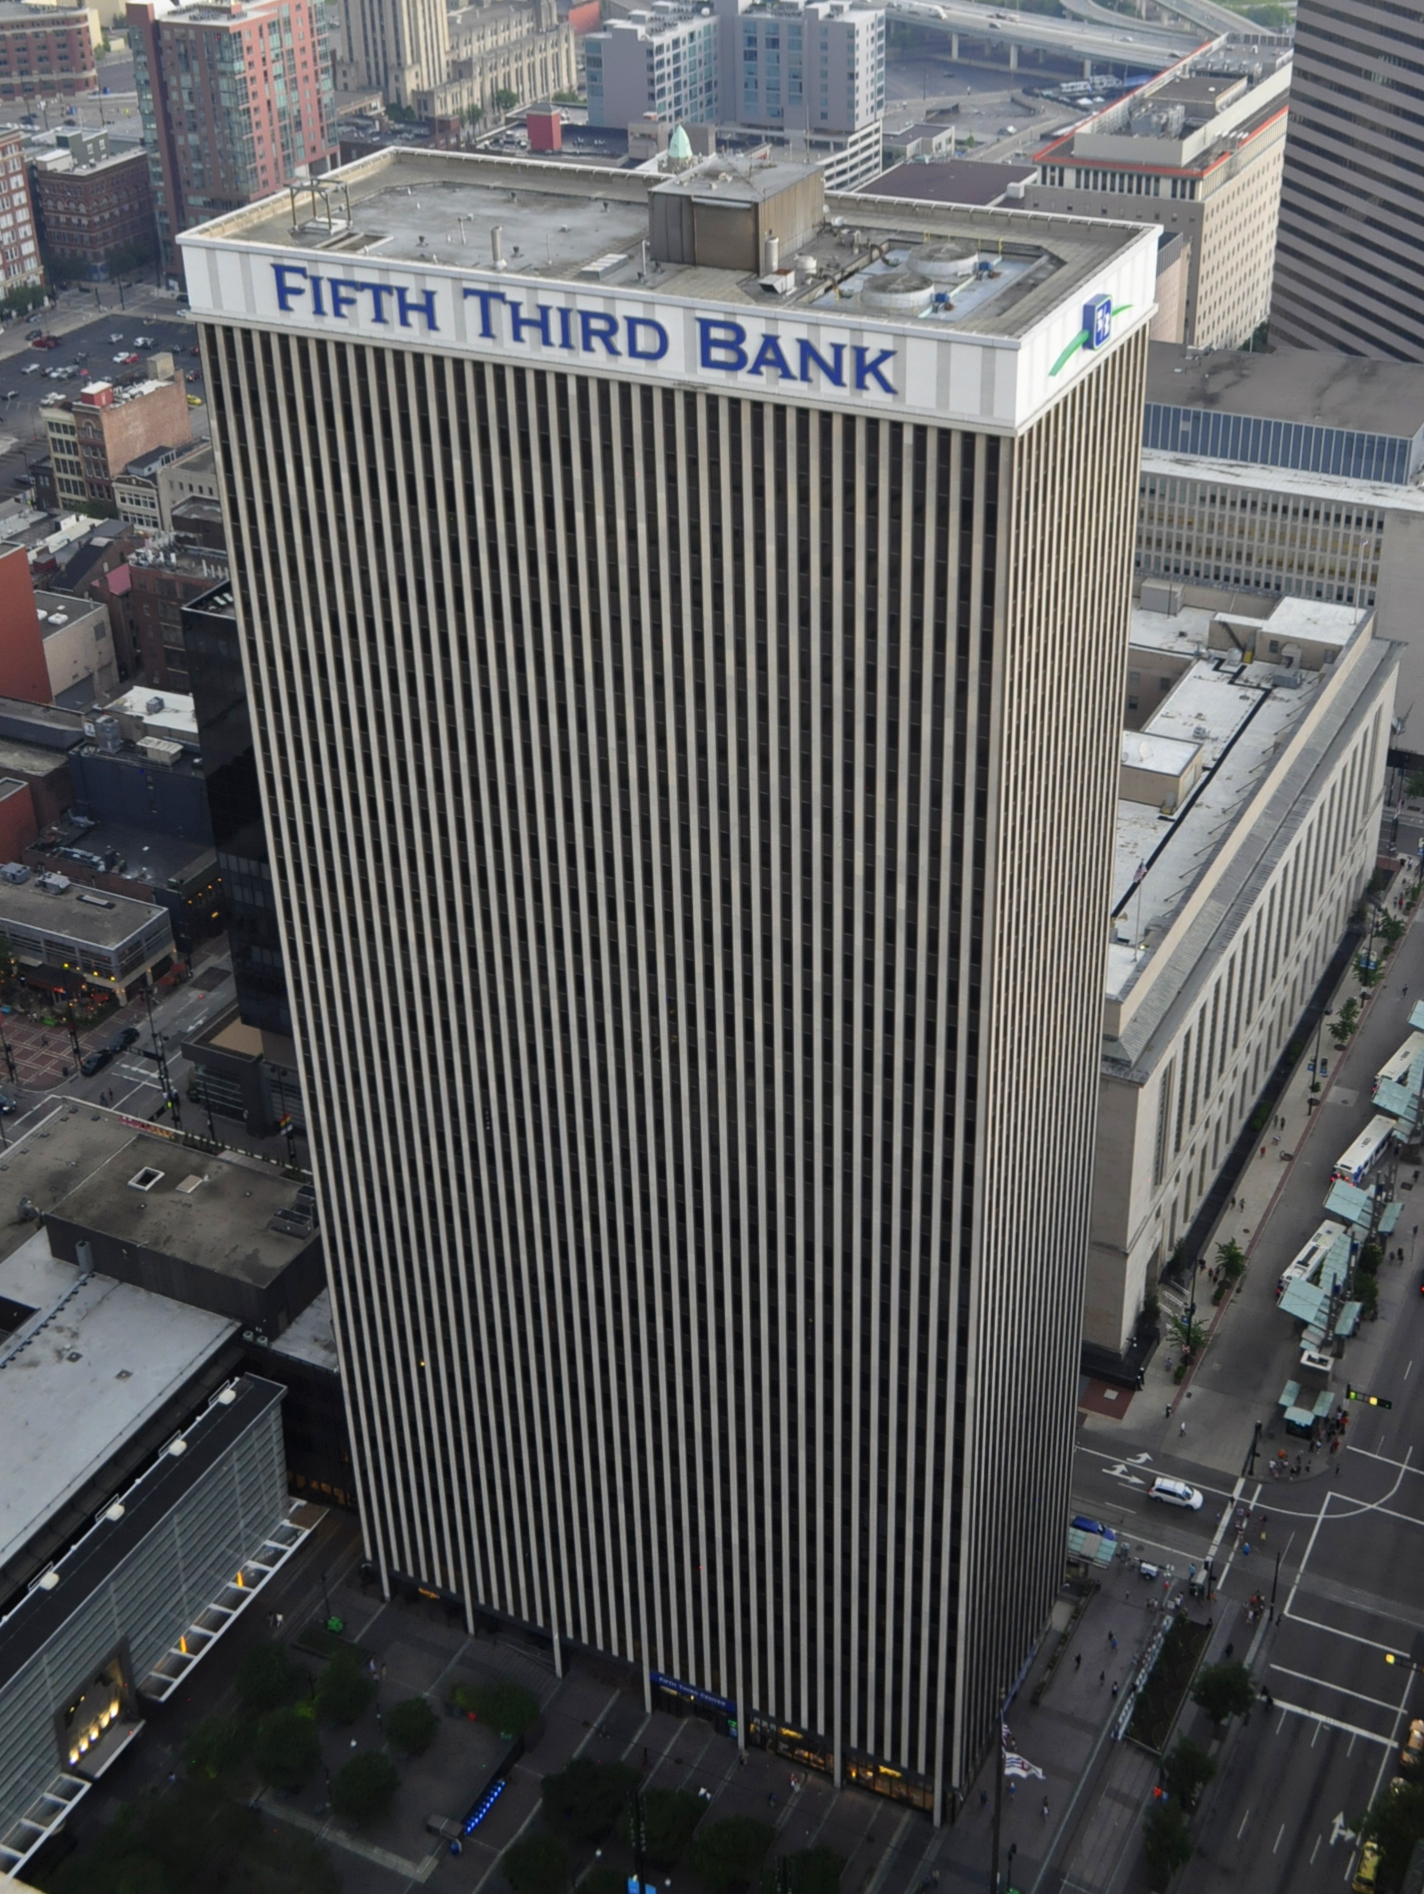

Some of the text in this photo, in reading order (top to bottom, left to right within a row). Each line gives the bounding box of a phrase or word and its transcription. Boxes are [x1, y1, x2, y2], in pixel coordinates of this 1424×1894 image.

[270, 262, 899, 395] FIFTH THIRD BANK
